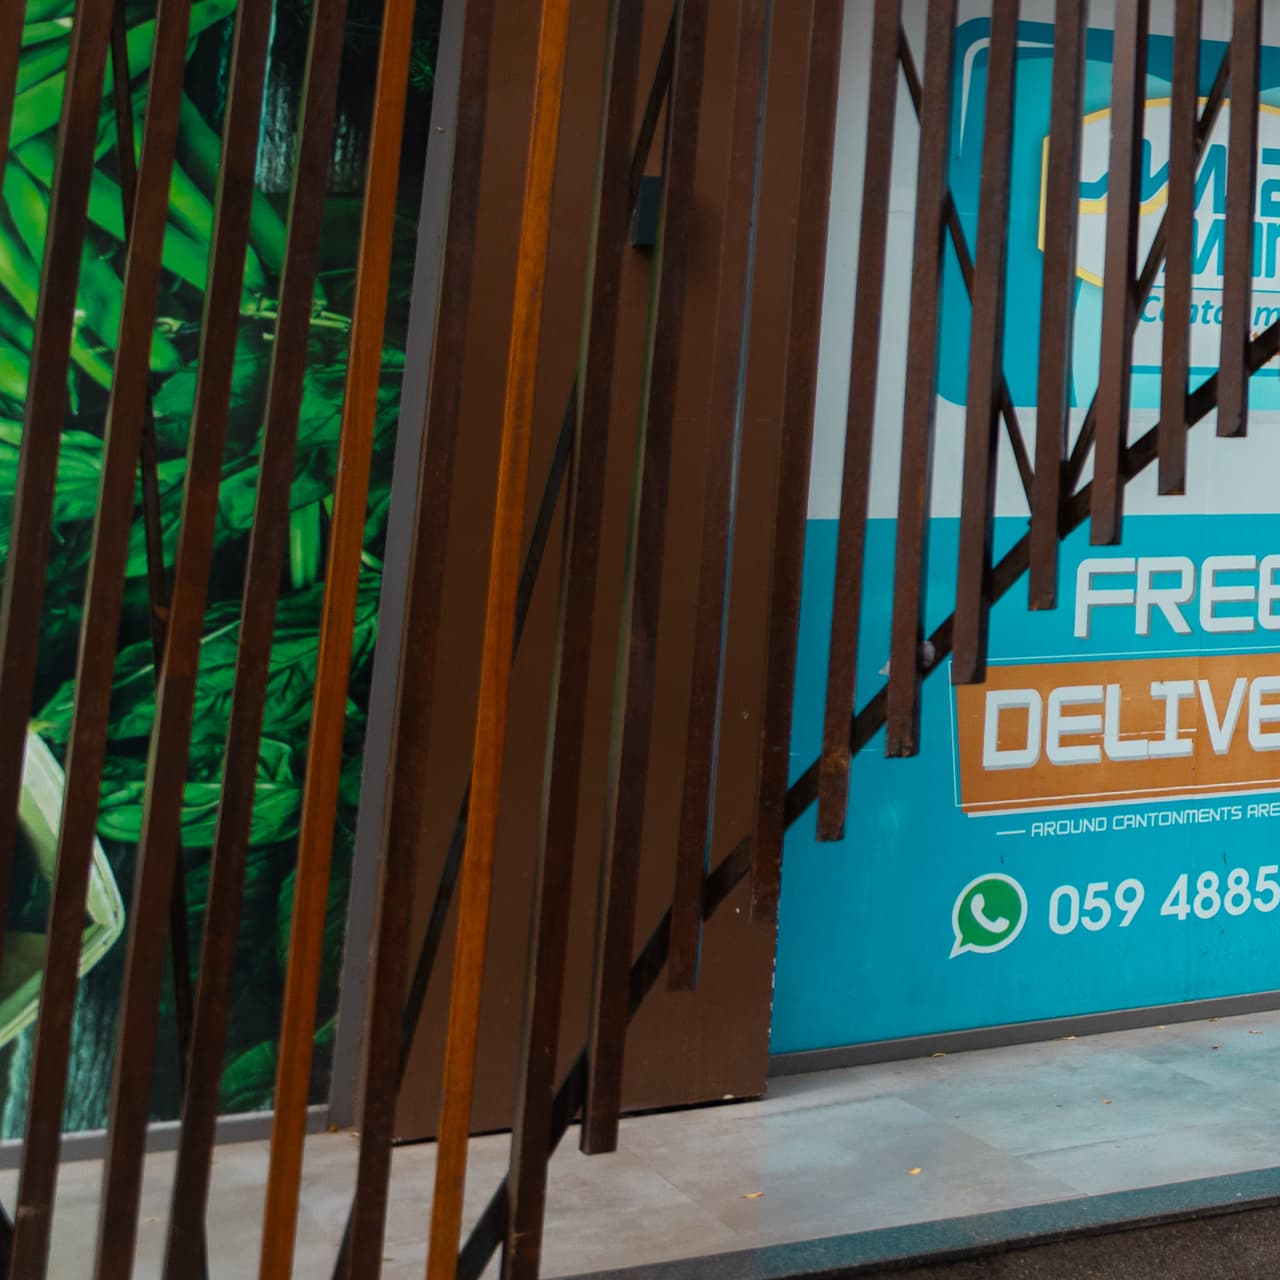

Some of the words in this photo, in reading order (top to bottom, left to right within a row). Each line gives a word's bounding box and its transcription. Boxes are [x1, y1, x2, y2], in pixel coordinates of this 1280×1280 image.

[1031, 816, 1107, 838] AROUND
[1112, 805, 1242, 831] CANTONMENTS
[1048, 878, 1145, 934] 059
